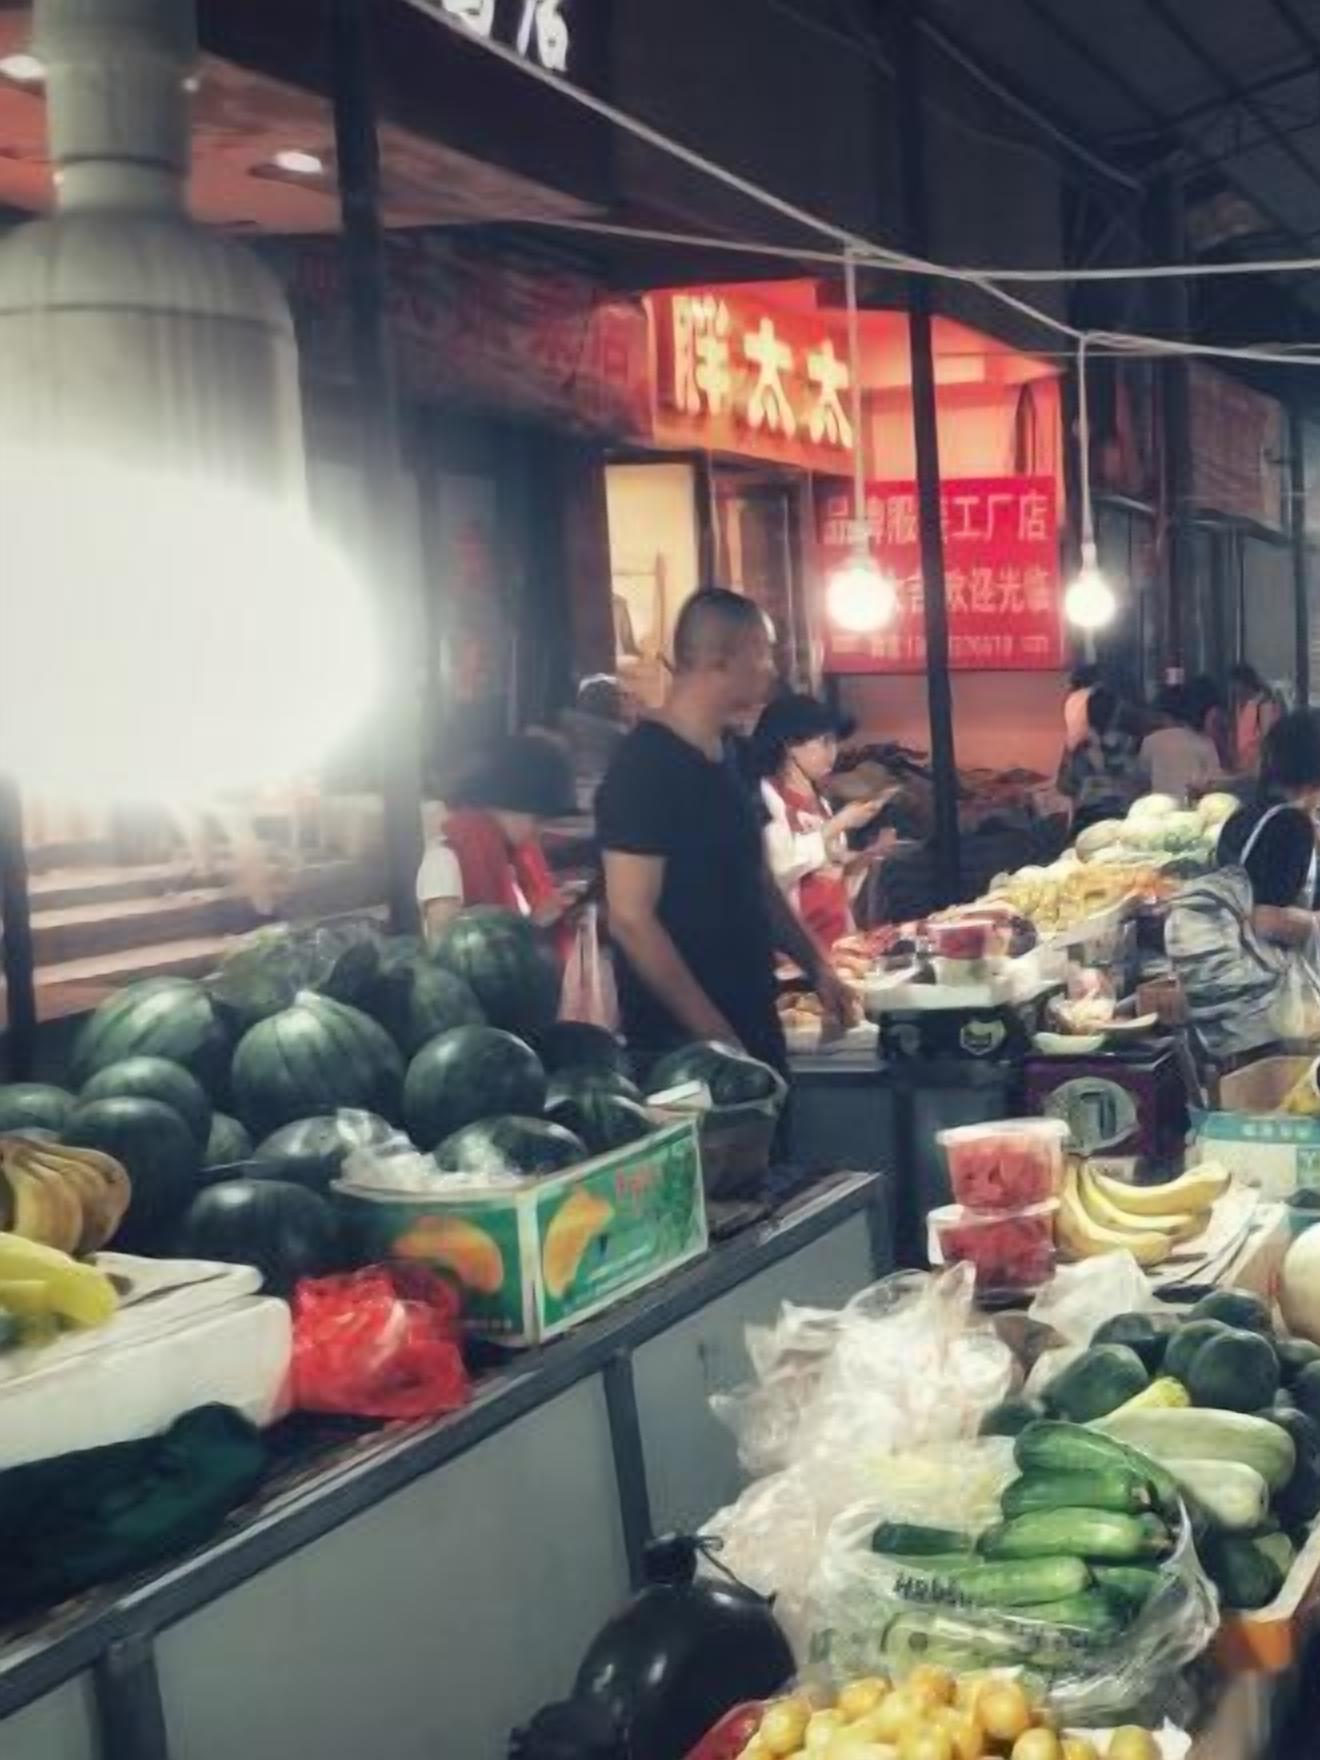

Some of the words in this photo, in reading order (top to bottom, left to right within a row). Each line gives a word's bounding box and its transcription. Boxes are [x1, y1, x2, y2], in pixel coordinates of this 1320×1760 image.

[672, 294, 852, 448] 胖太太
[822, 491, 1050, 545] 品牌服工厂店
